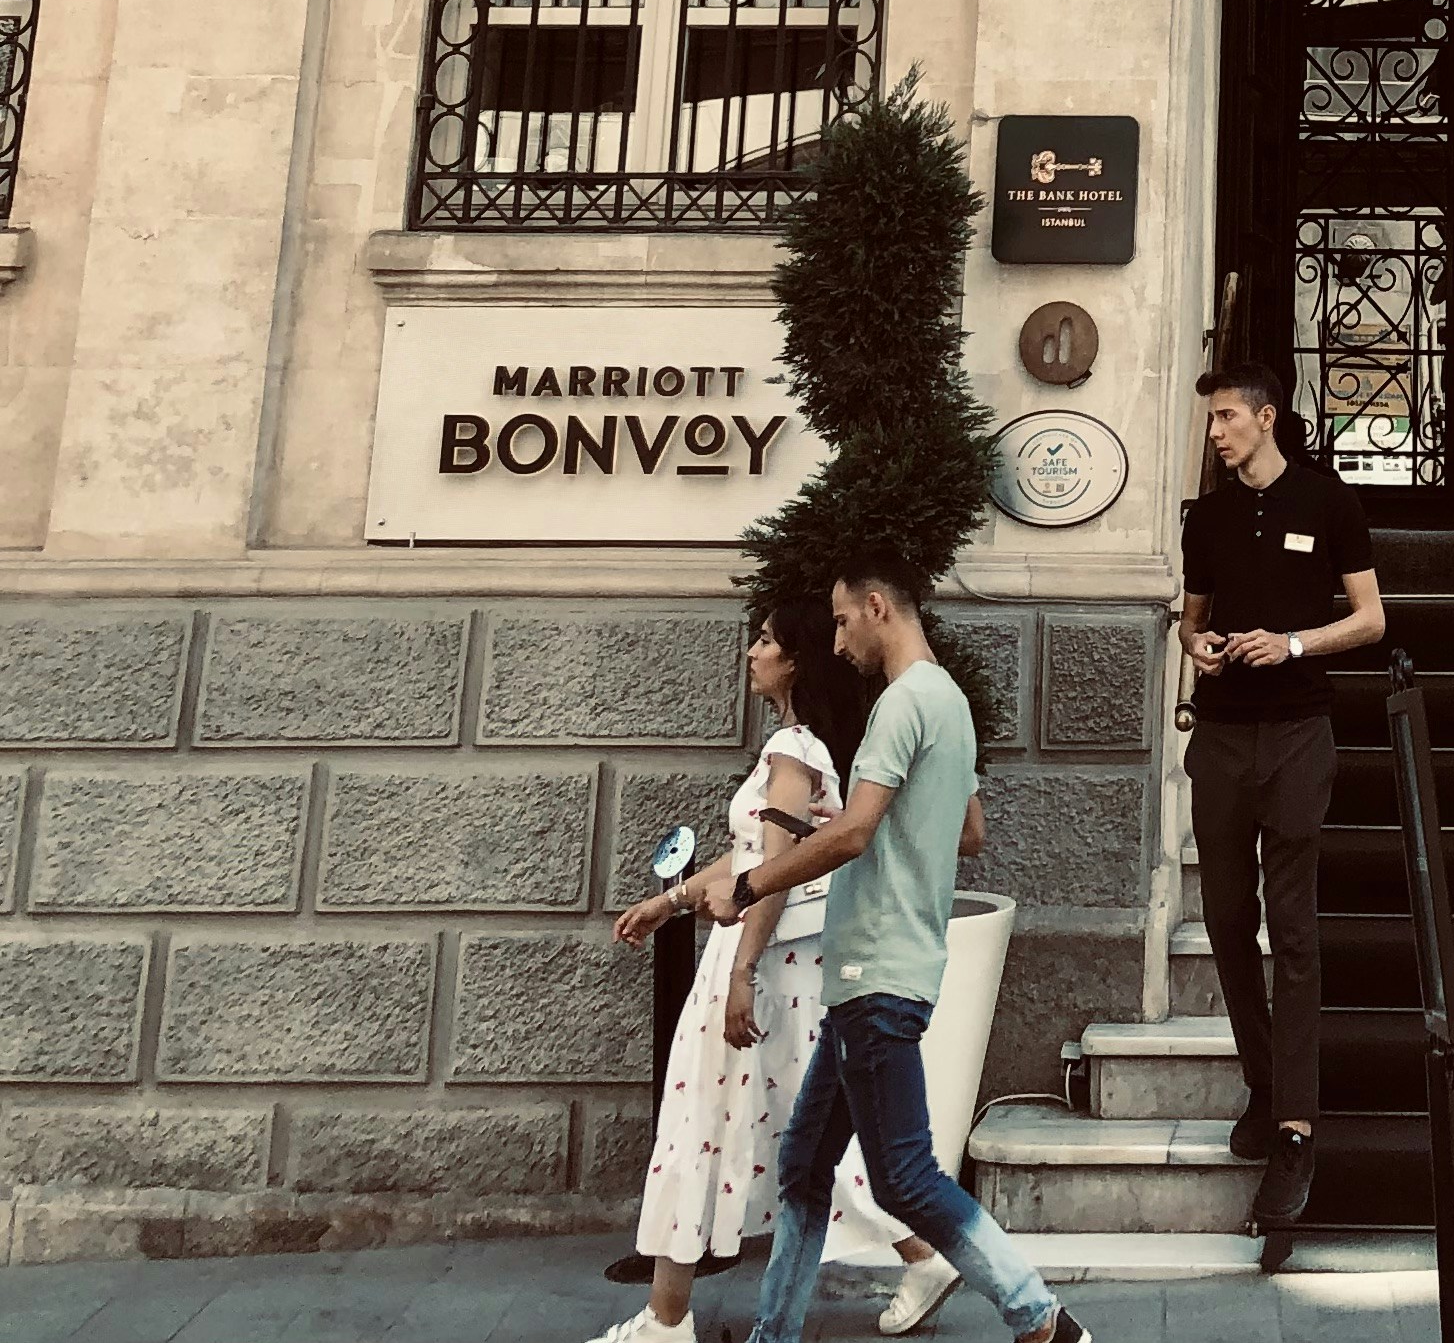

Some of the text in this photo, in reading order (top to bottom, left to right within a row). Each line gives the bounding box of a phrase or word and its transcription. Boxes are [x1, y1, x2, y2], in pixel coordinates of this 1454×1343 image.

[1007, 190, 1123, 201] THE BANK HOTEL
[1041, 218, 1086, 227] ISTANBUL
[492, 365, 745, 398] MARRIOTT
[438, 413, 787, 476] BONVOY
[1042, 458, 1068, 467] SAFE
[1032, 466, 1078, 476] TOURISM
